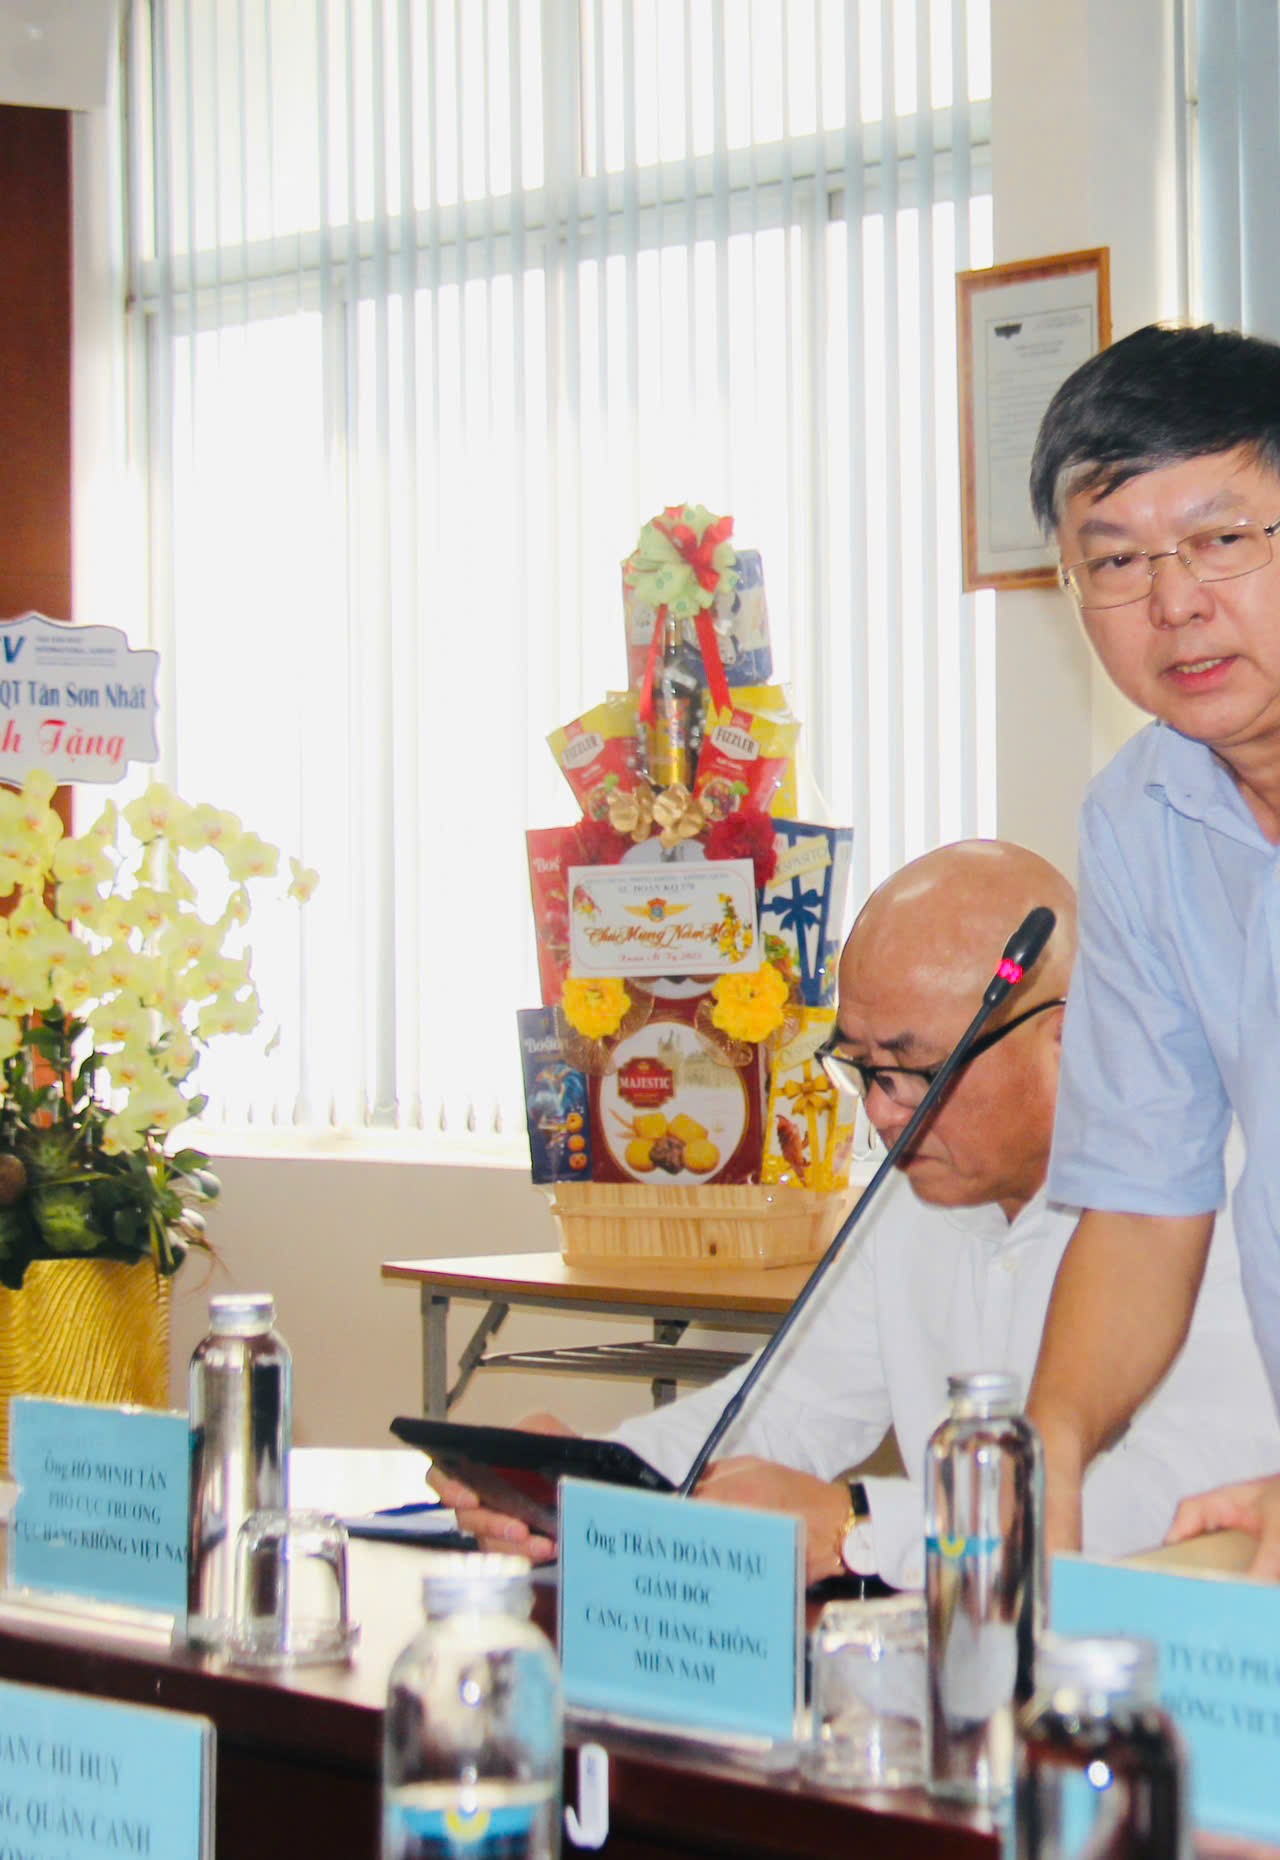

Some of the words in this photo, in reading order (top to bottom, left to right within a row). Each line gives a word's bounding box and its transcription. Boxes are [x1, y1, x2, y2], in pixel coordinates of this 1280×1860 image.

[715, 728, 755, 754] FIZZLER
[620, 1077, 670, 1089] MAJESTIC
[95, 1463, 134, 1486] MINH
[586, 1517, 617, 1554] Ông
[164, 1542, 187, 1564] NA
[708, 1628, 768, 1660] KHÔNG
[679, 1657, 716, 1684] NAM
[79, 1748, 123, 1787] HUY
